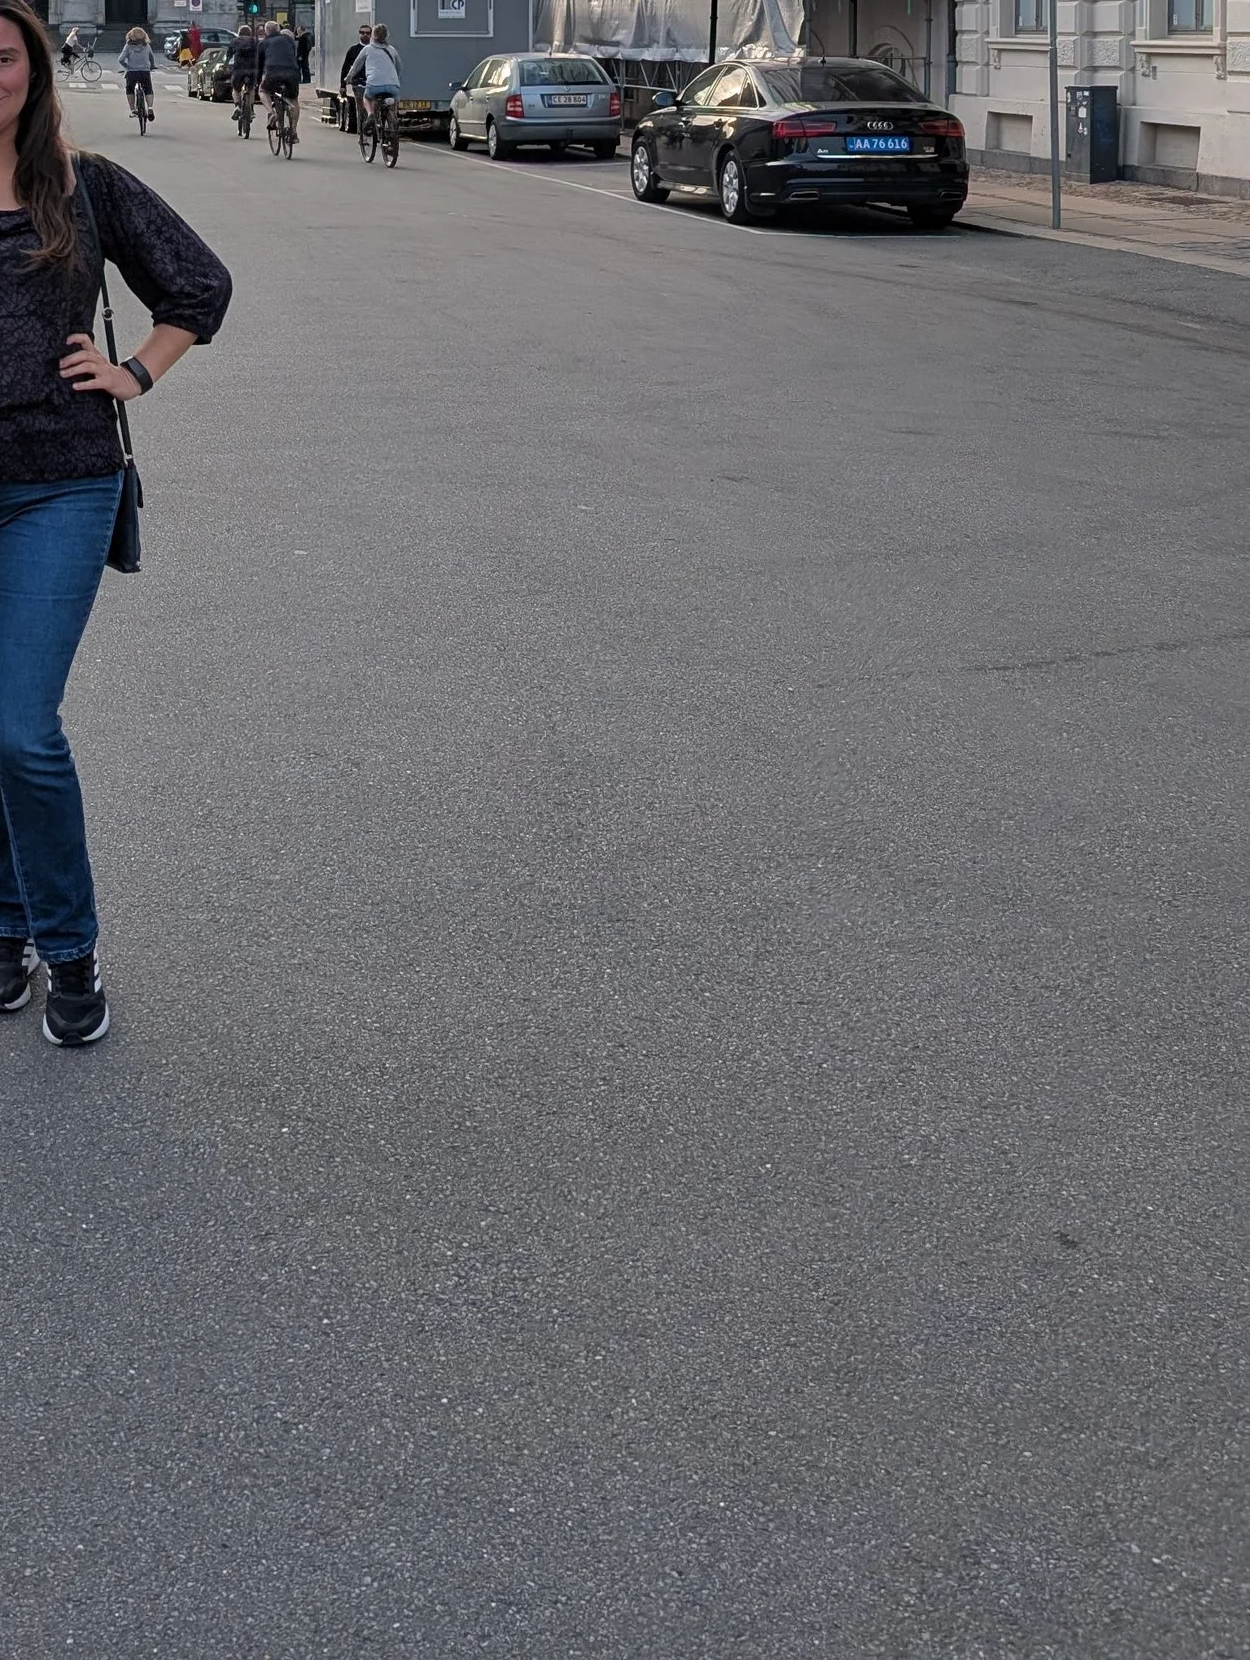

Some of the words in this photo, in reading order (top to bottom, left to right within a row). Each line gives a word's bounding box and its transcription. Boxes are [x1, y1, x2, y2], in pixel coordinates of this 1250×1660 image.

[855, 139, 871, 149] AA
[872, 139, 886, 149] 76
[887, 139, 907, 149] 616
